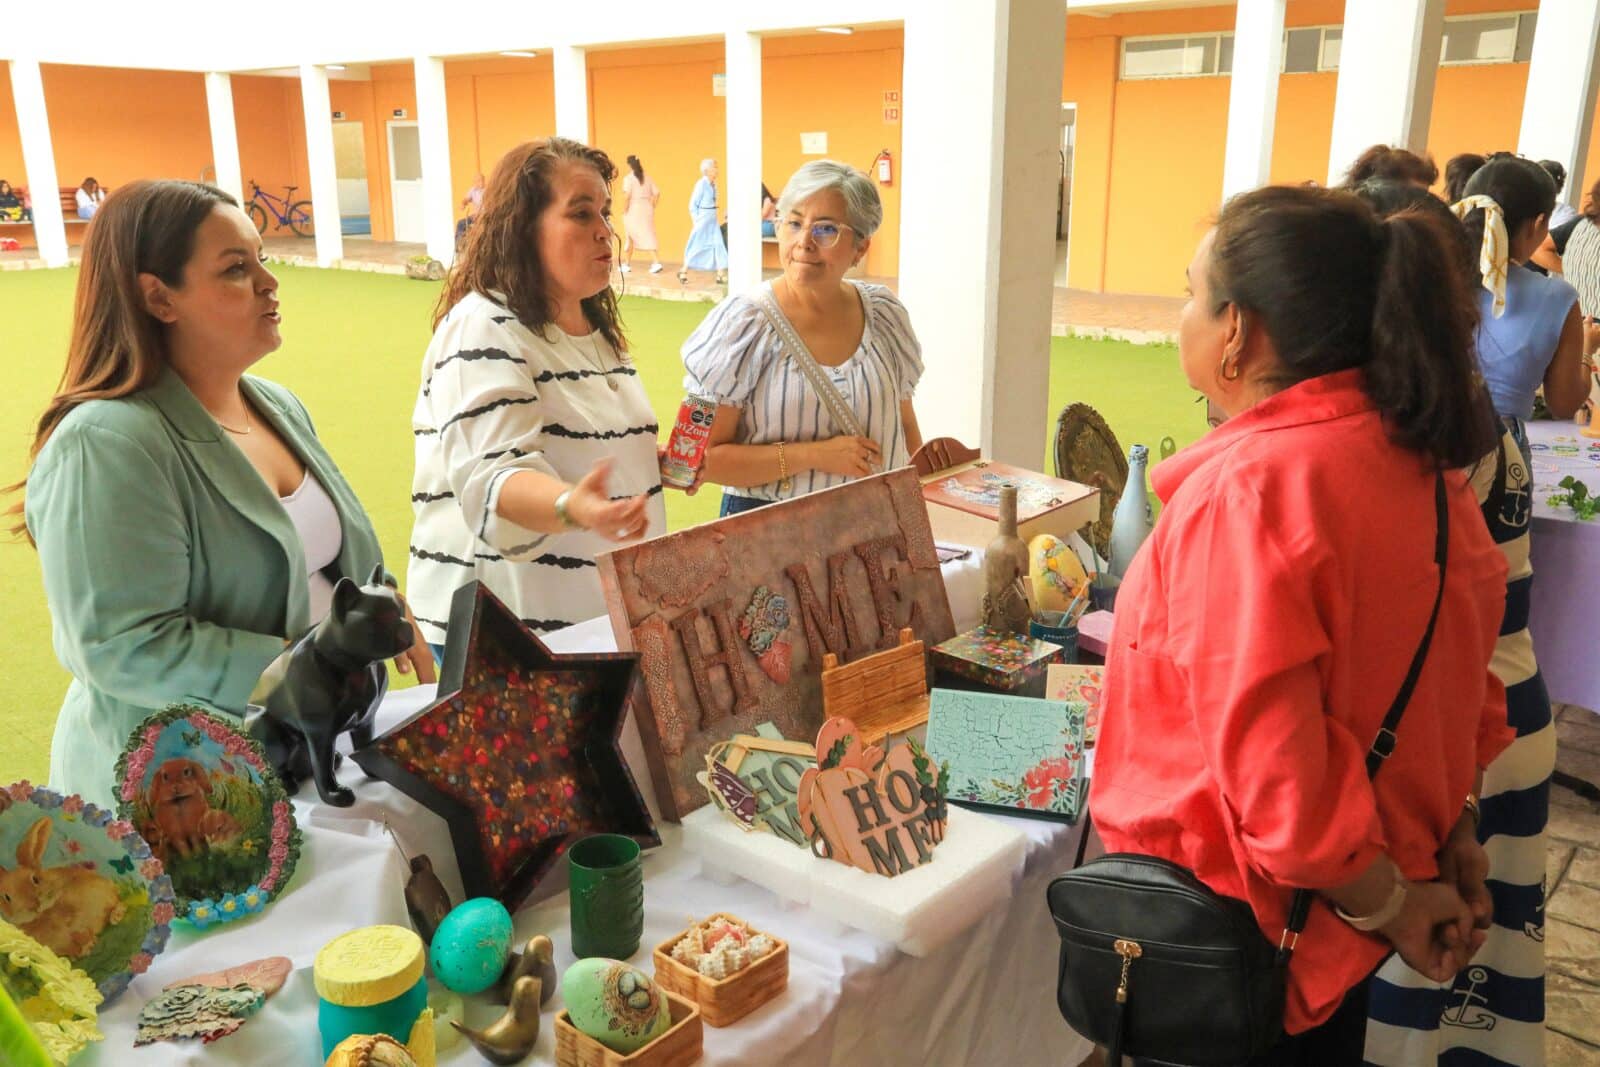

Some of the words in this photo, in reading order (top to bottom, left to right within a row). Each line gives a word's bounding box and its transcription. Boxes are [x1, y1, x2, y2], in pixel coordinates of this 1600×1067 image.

[671, 534, 924, 731] HME
[761, 802, 808, 845] M
[842, 769, 921, 833] HO
[861, 812, 933, 877] ME
